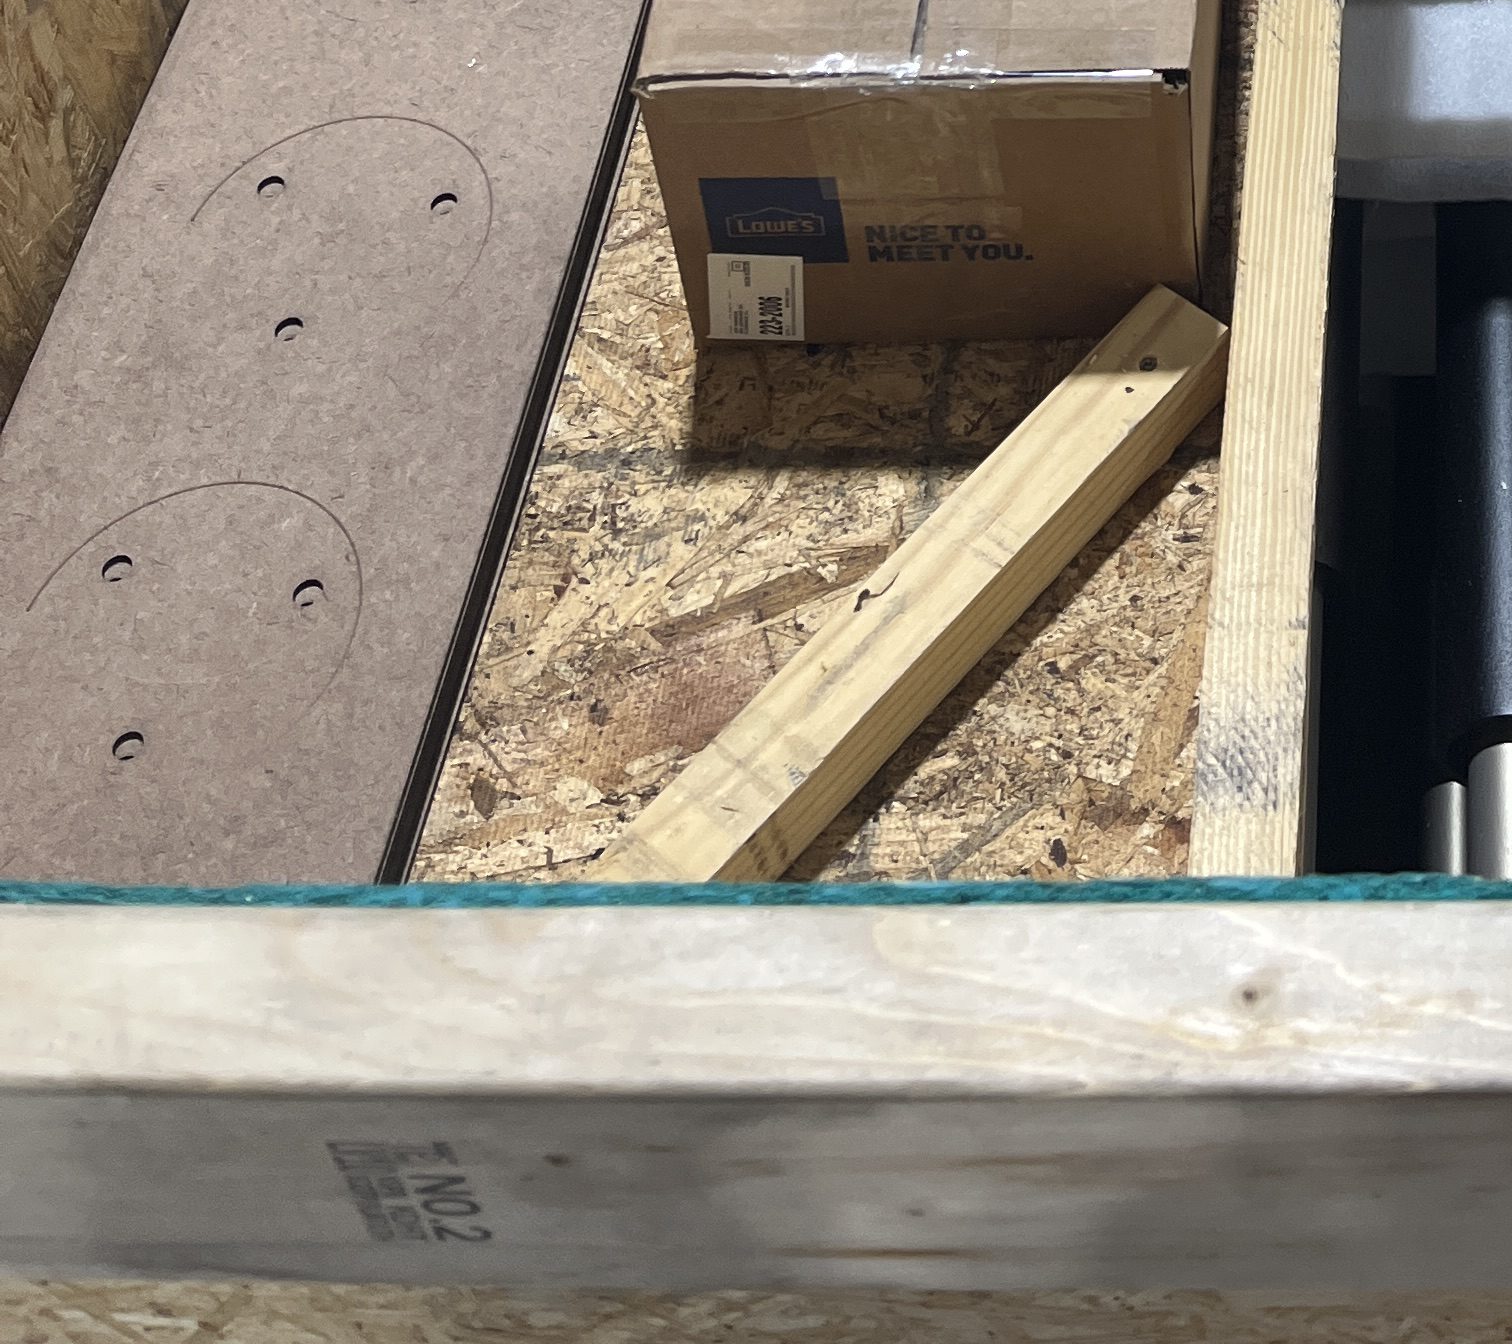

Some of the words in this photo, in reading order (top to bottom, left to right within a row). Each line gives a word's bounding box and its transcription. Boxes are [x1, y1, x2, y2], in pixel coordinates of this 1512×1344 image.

[737, 218, 815, 237] LOWE'S
[864, 224, 943, 244] NICE
[945, 223, 987, 243] TO
[868, 244, 958, 263] MEET
[959, 243, 1034, 263] YOU.
[407, 1173, 493, 1242] NO.2
